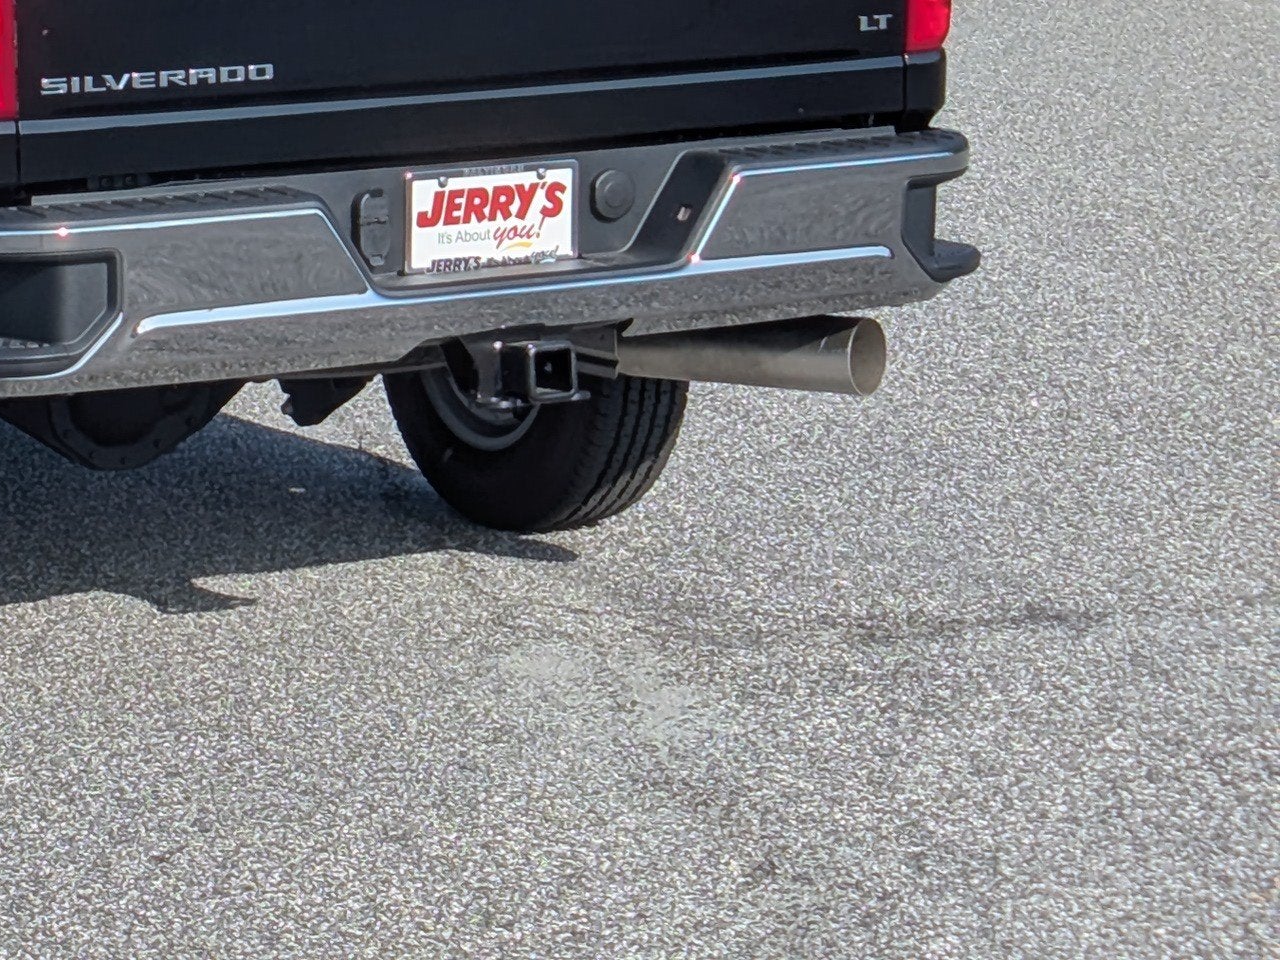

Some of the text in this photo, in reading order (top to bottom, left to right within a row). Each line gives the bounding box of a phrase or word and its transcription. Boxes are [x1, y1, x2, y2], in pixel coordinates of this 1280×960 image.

[858, 13, 893, 32] LT
[40, 63, 274, 96] SILVERADO
[416, 181, 567, 228] JERRY'S
[437, 216, 546, 250] It's About you!
[426, 256, 481, 273] JERRY'S
